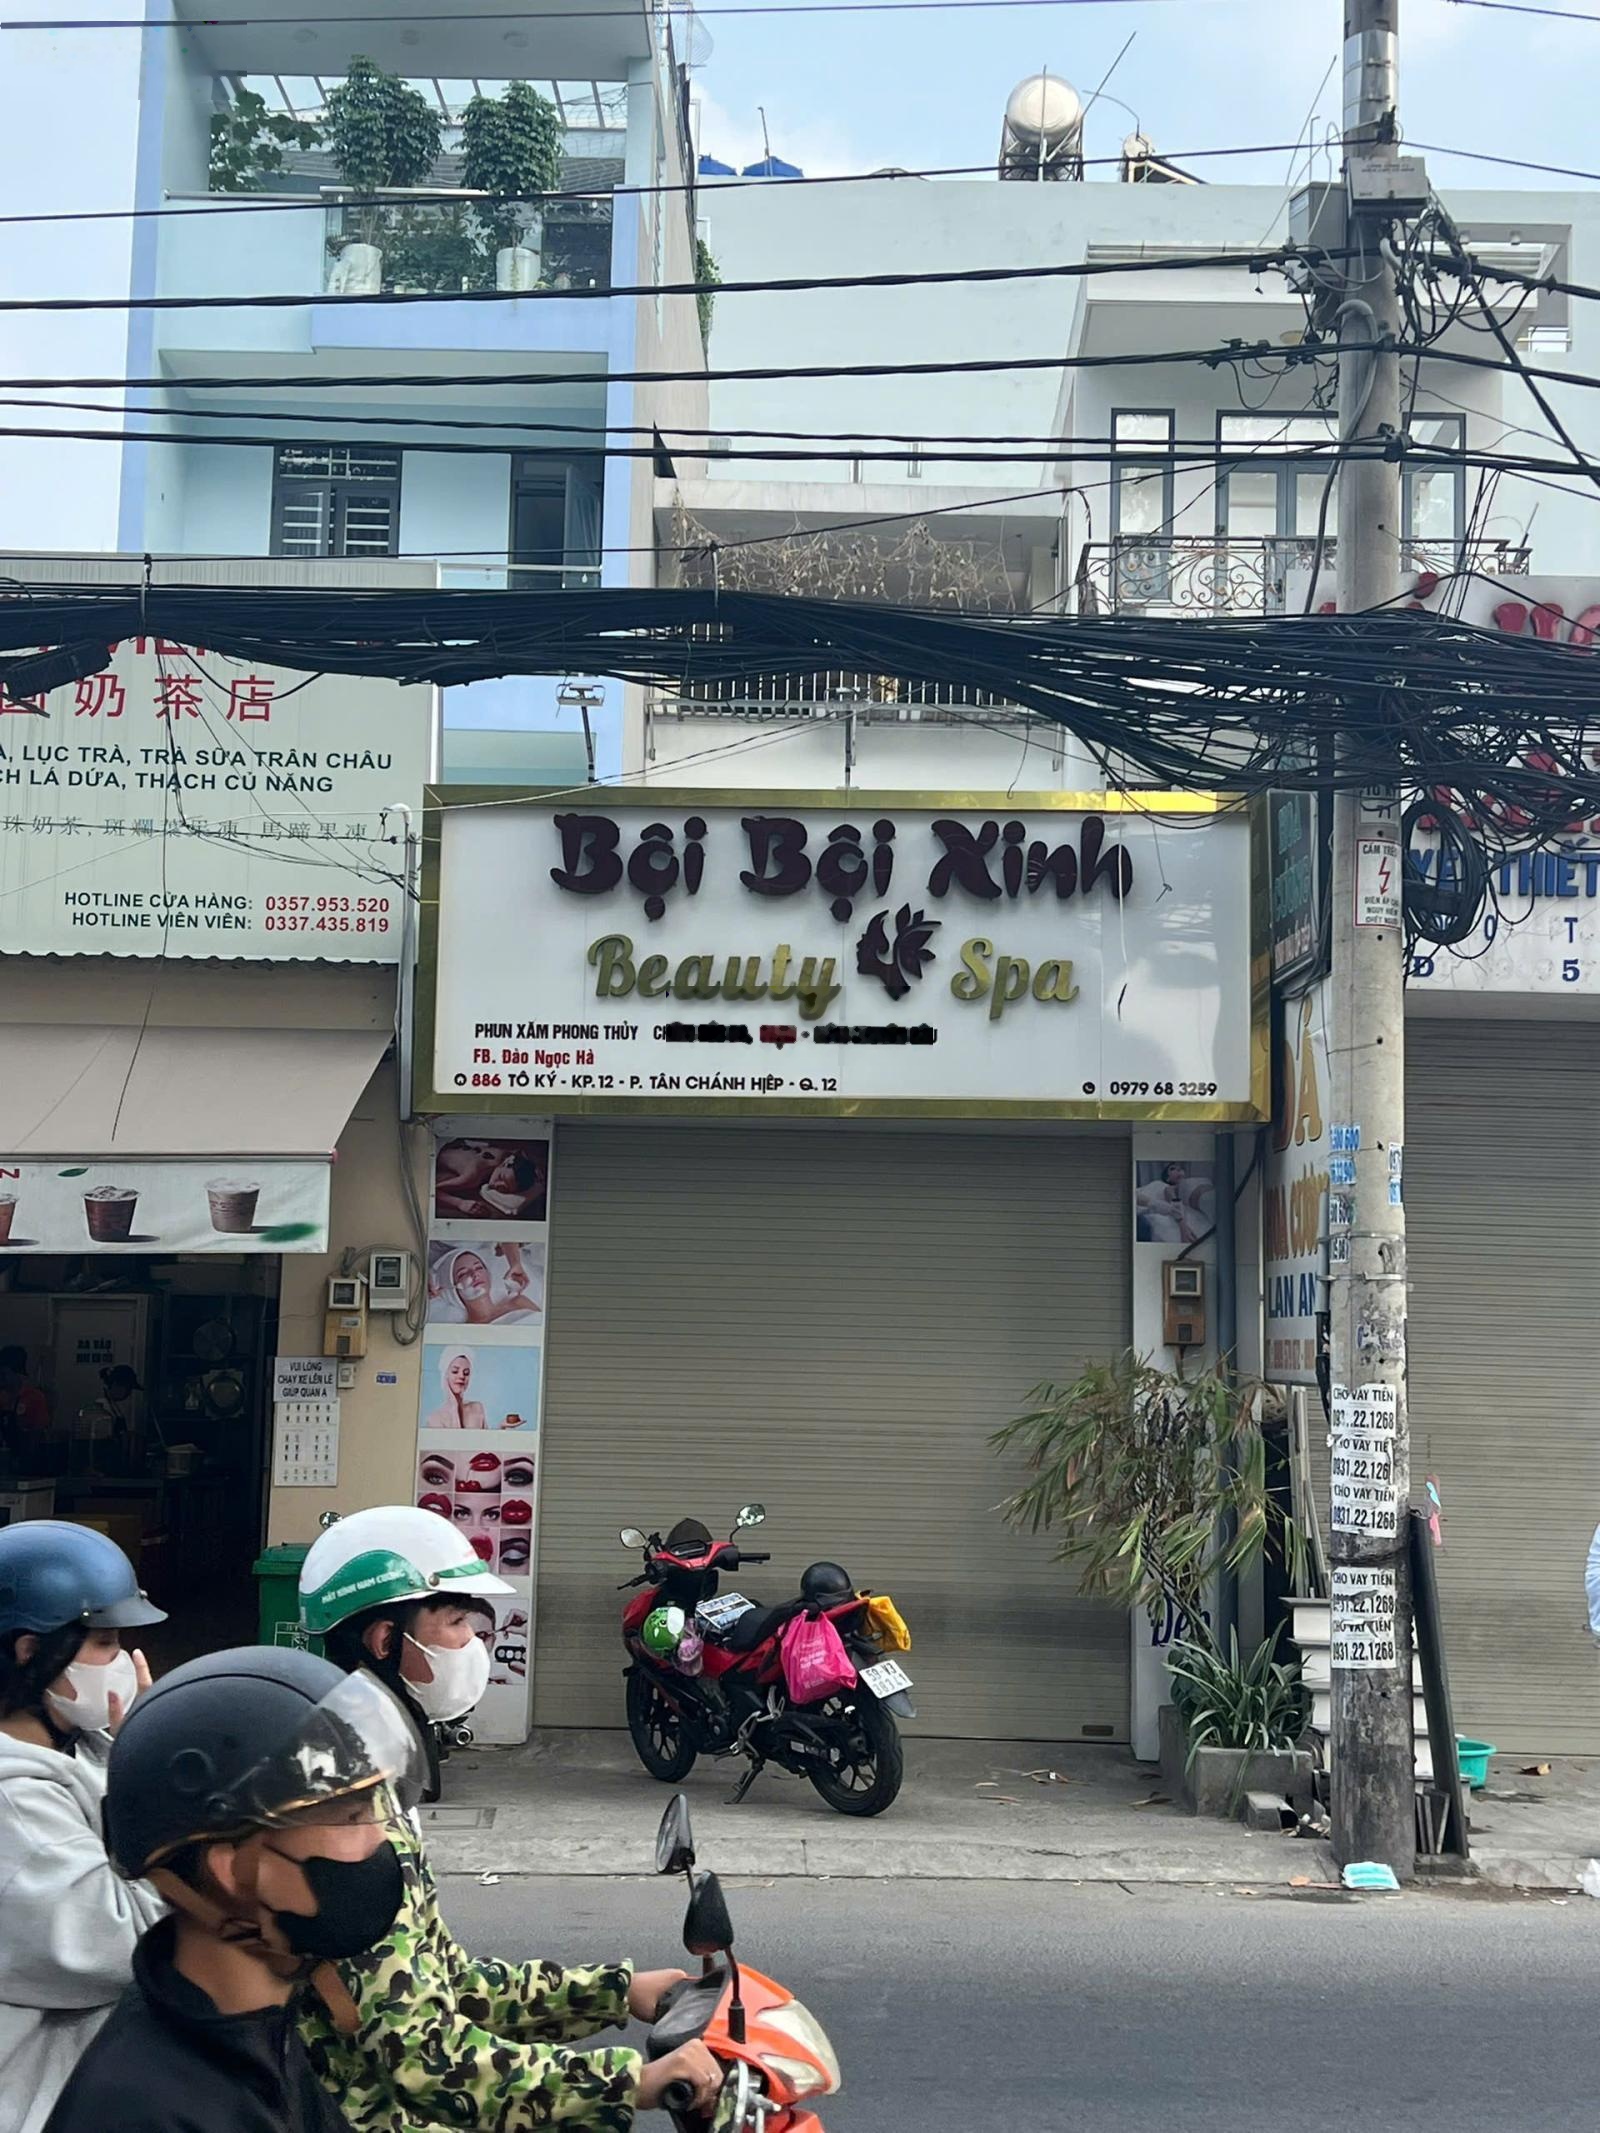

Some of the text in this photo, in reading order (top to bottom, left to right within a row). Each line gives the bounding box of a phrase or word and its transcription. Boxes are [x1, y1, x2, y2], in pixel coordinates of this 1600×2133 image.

[23, 745, 69, 763] LỤC
[78, 744, 131, 766] TRÀ,
[140, 746, 188, 766] TRÀ
[196, 747, 246, 767] SỮA
[255, 748, 317, 768] TRÂN
[326, 750, 392, 769] CHÂU
[30, 767, 58, 786] LÁ
[225, 771, 257, 791] CỦ
[266, 773, 333, 792] NĂNG
[549, 812, 1133, 923] Bội Bội Xinh
[65, 891, 390, 912] HOTLINE CỬA HÀNG: 0357.953.520
[72, 911, 389, 932] HOTLINE VIÊN VIÊN: 0337.435.819
[1563, 916, 1579, 944] T
[587, 933, 1079, 1021] Beauty Spa
[1561, 959, 1581, 982] 5
[474, 1023, 513, 1039] PHUN
[516, 1020, 549, 1039] XĂM
[552, 1024, 599, 1040] PHONG
[603, 1021, 639, 1041] THỦY
[473, 1048, 595, 1068] FB. Đào Ngọc Hà
[471, 1073, 501, 1087] 886
[508, 1070, 530, 1087] TÔ
[535, 1070, 558, 1088] KÝ
[629, 1075, 643, 1090] P.
[649, 1072, 680, 1090] TÂN
[685, 1072, 745, 1091] CHÁNH
[751, 1073, 784, 1095] HIỆP
[822, 1077, 838, 1092] 12
[1109, 1081, 1218, 1097] 0979 68 3259
[1268, 1274, 1294, 1318] LAN
[1352, 1388, 1369, 1400] VAY
[1353, 1439, 1370, 1451] VAY
[1333, 1484, 1350, 1498] CHO
[1353, 1487, 1372, 1500] VAY
[1350, 1573, 1369, 1586] VAY
